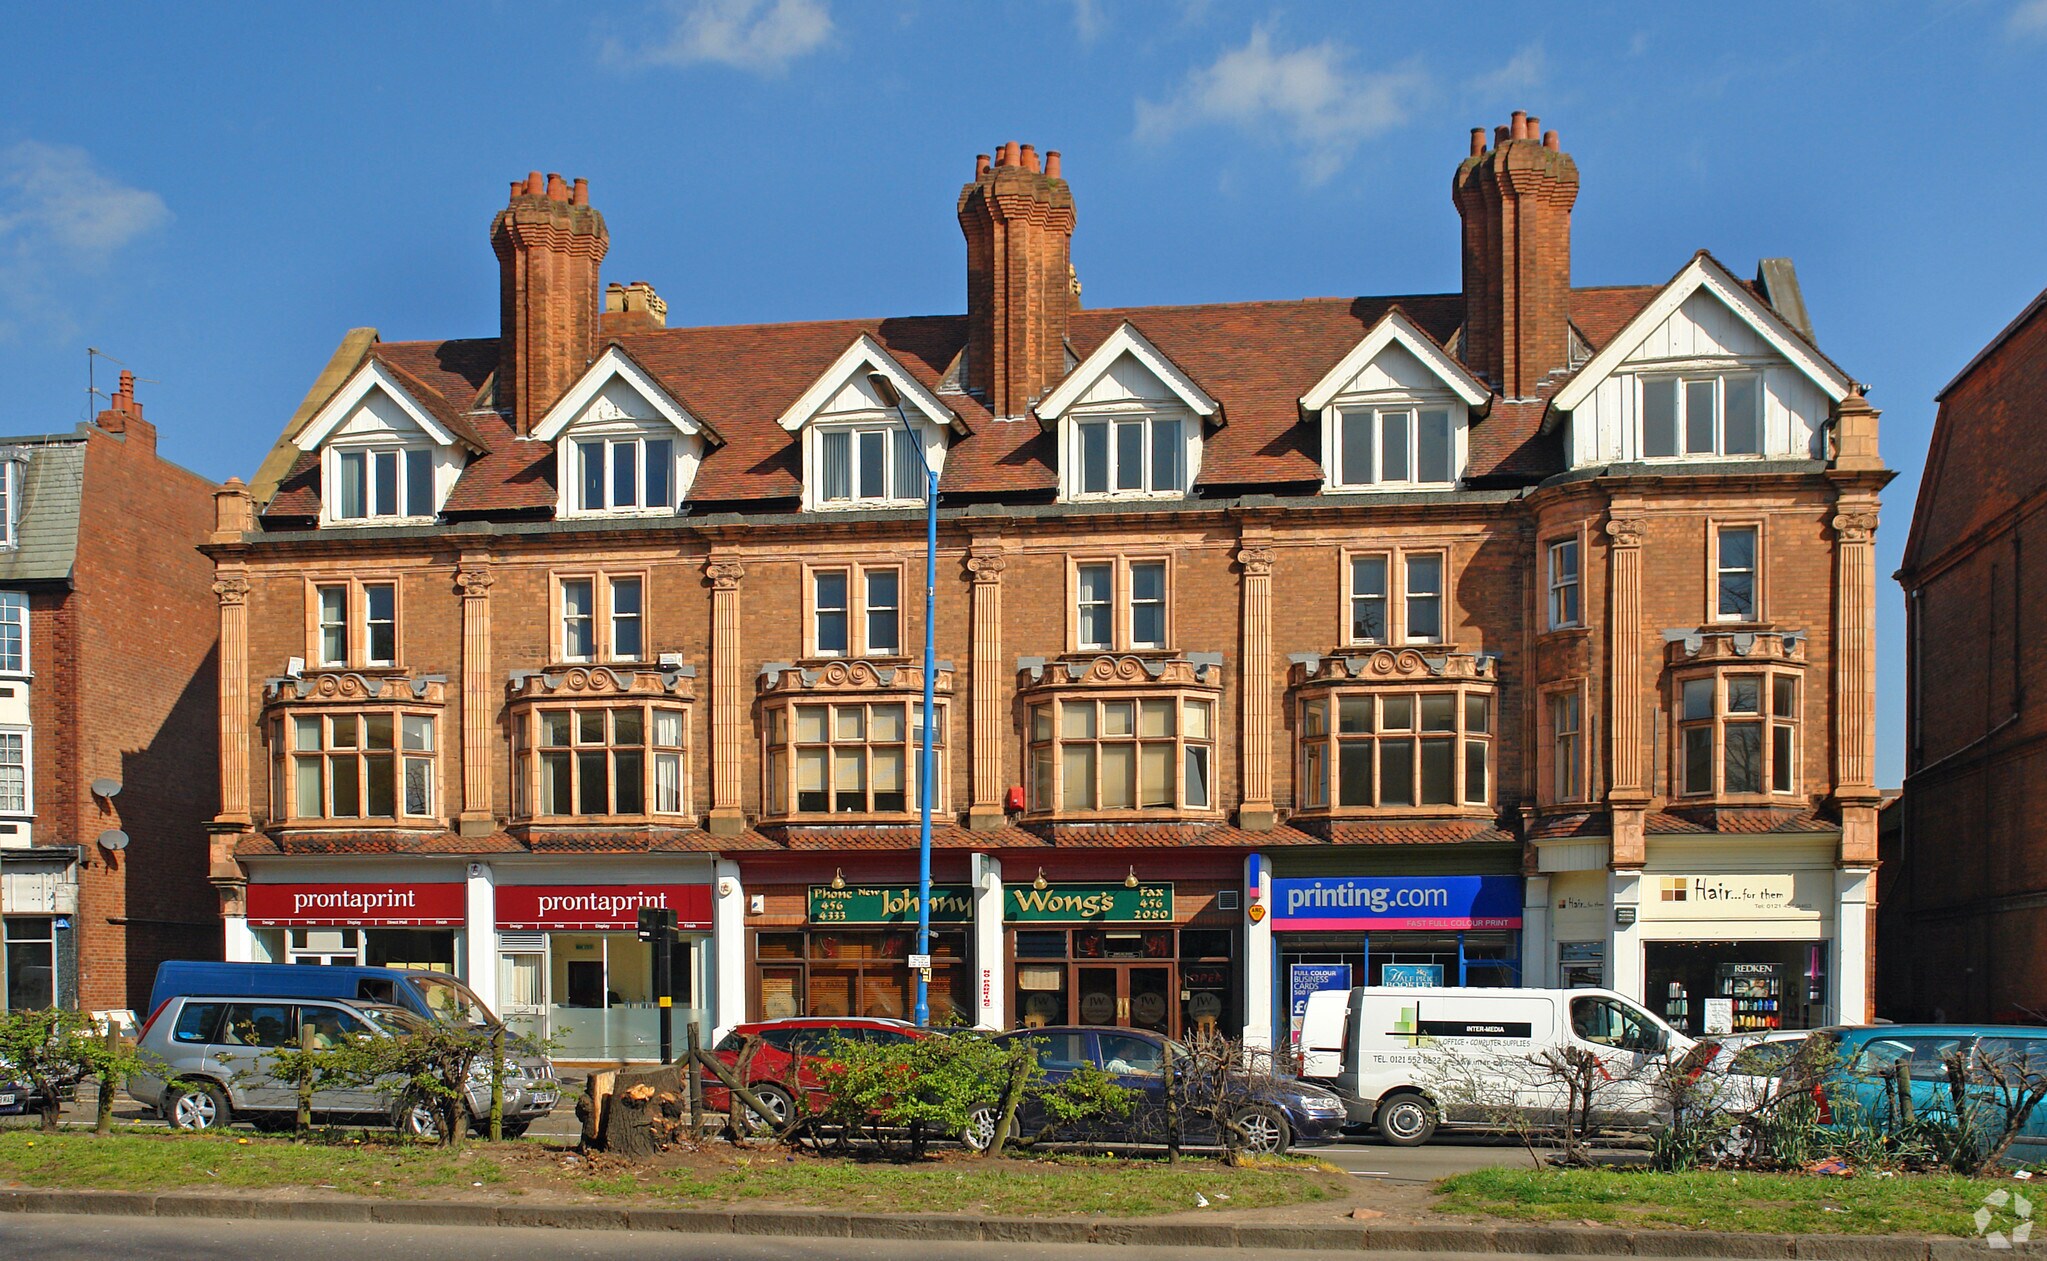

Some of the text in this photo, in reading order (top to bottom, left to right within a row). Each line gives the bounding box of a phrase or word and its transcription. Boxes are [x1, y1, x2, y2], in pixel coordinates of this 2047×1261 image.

[814, 888, 852, 899] Phone
[1138, 887, 1164, 897] Fax
[1760, 888, 1784, 899] them
[294, 889, 416, 914] prontaprint
[1288, 881, 1448, 915] printing.com
[538, 891, 668, 917] prontaprint
[820, 901, 843, 910] 456
[857, 888, 973, 918] New Johnny
[1013, 889, 1114, 917] Wong's
[1139, 899, 1163, 908] 456
[818, 911, 846, 920] 4333
[1134, 910, 1169, 919] 2080
[1406, 919, 1509, 927] FAST FULL COLOUR PRINT
[983, 969, 990, 977] NO
[1734, 964, 1773, 973] REDKEN
[1294, 982, 1319, 990] CARDS
[1466, 1025, 1505, 1033] INTER-MEDIA
[1442, 1038, 1465, 1046] OFFICE
[1470, 1039, 1502, 1047] COMPUTER
[1390, 1055, 1406, 1064] 0121
[1408, 1055, 1422, 1064] 552
